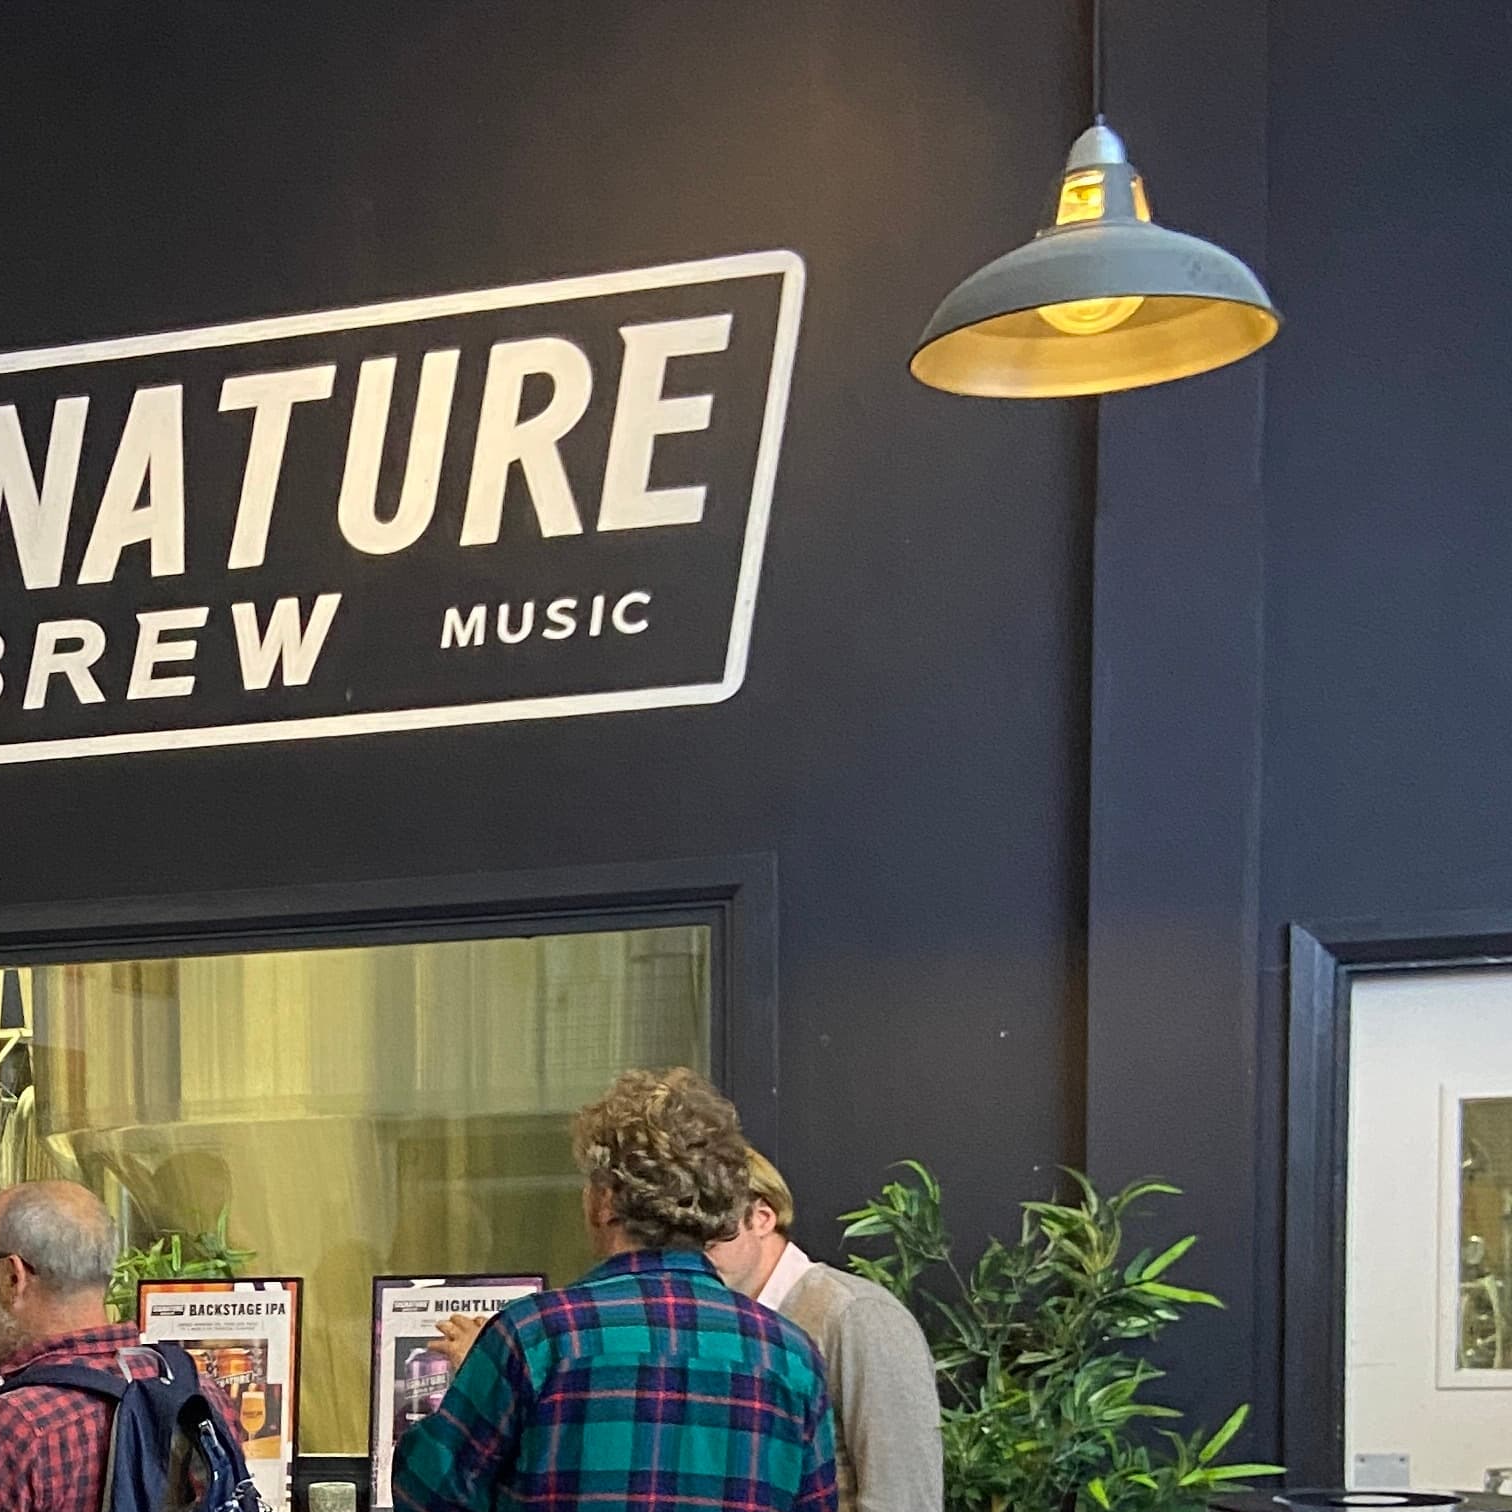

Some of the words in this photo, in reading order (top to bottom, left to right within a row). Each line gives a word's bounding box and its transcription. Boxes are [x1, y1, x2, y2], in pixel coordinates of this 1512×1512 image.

[440, 592, 651, 649] MUSIC
[189, 1303, 262, 1316] BACKSTAGE
[266, 1303, 286, 1315] IPA
